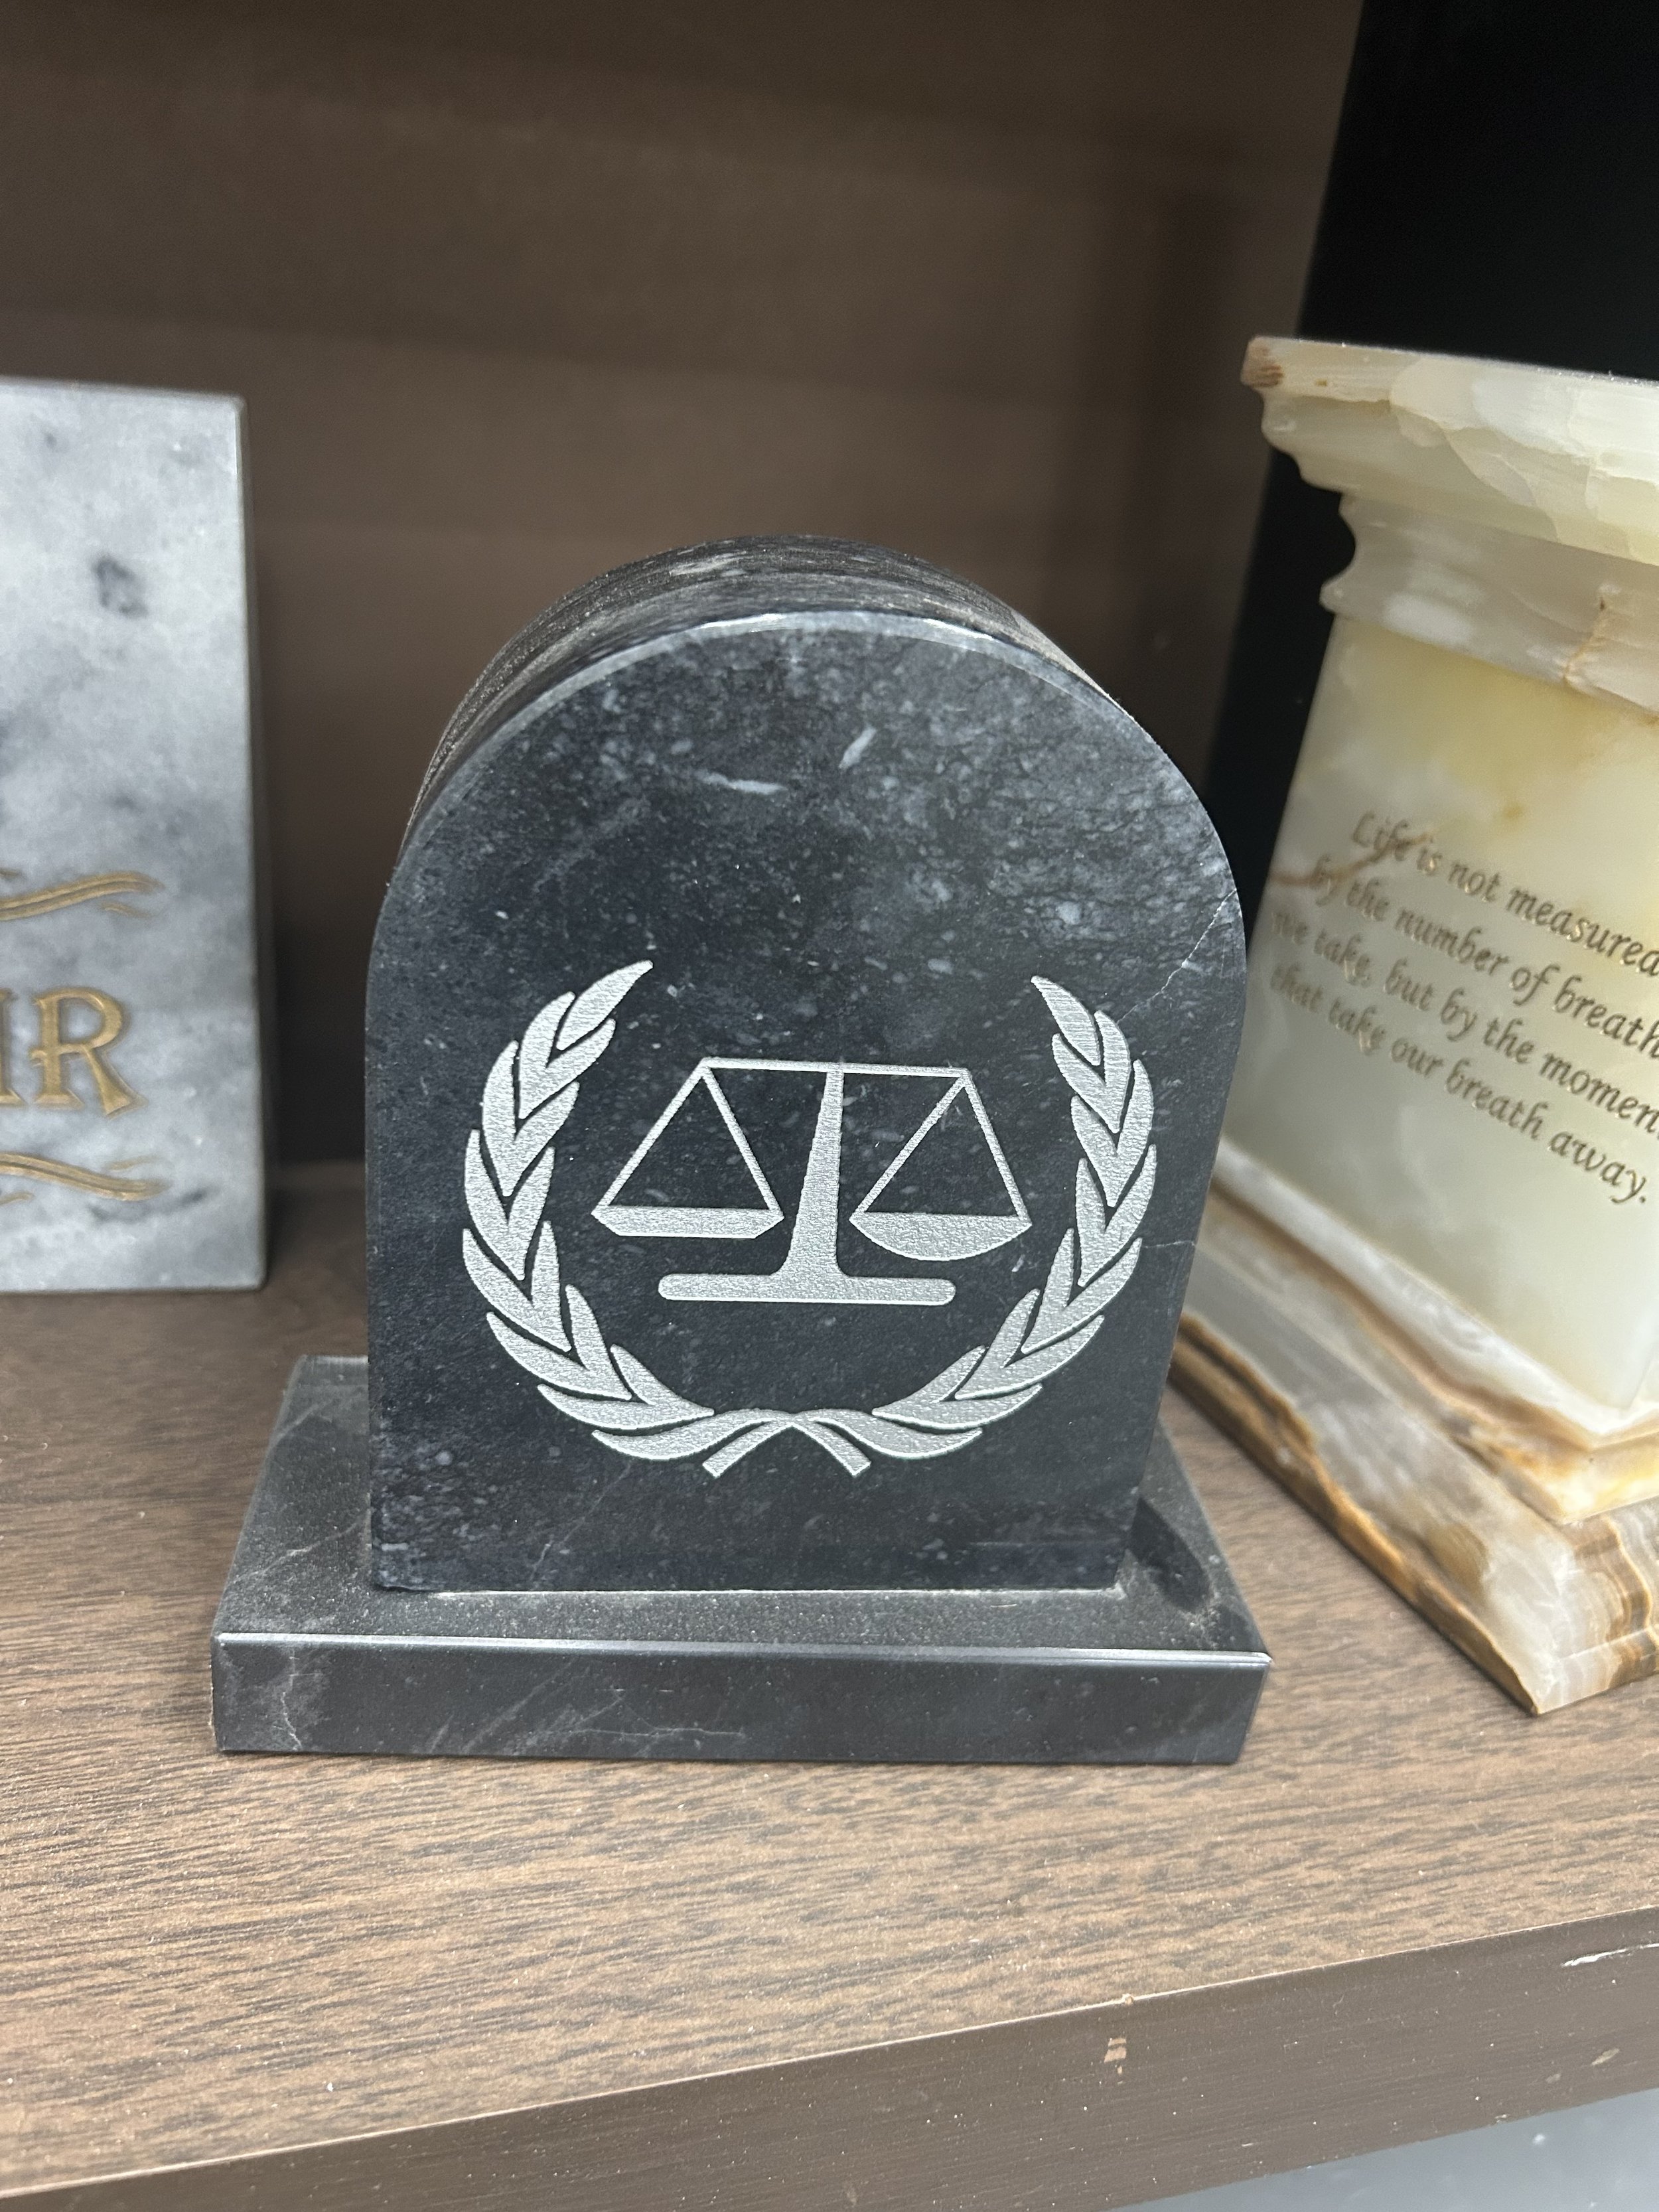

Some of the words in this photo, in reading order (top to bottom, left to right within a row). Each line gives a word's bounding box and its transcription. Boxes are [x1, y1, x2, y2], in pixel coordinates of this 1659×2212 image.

[1309, 853, 1342, 907] by
[1345, 878, 1390, 921] the
[1395, 908, 1509, 976] number
[1510, 964, 1561, 1007] of
[1415, 838, 1443, 876] is
[1447, 863, 1500, 903] not
[1269, 962, 1323, 1013] that
[1328, 997, 1388, 1057] take
[1391, 1037, 1444, 1078] our
[1445, 1057, 1550, 1140] breath
[1548, 1131, 1647, 1204] away.
[1384, 956, 1433, 1011] but
[1440, 988, 1478, 1042] by
[1482, 1017, 1536, 1064] the
[1539, 1052, 1659, 1140] momen
